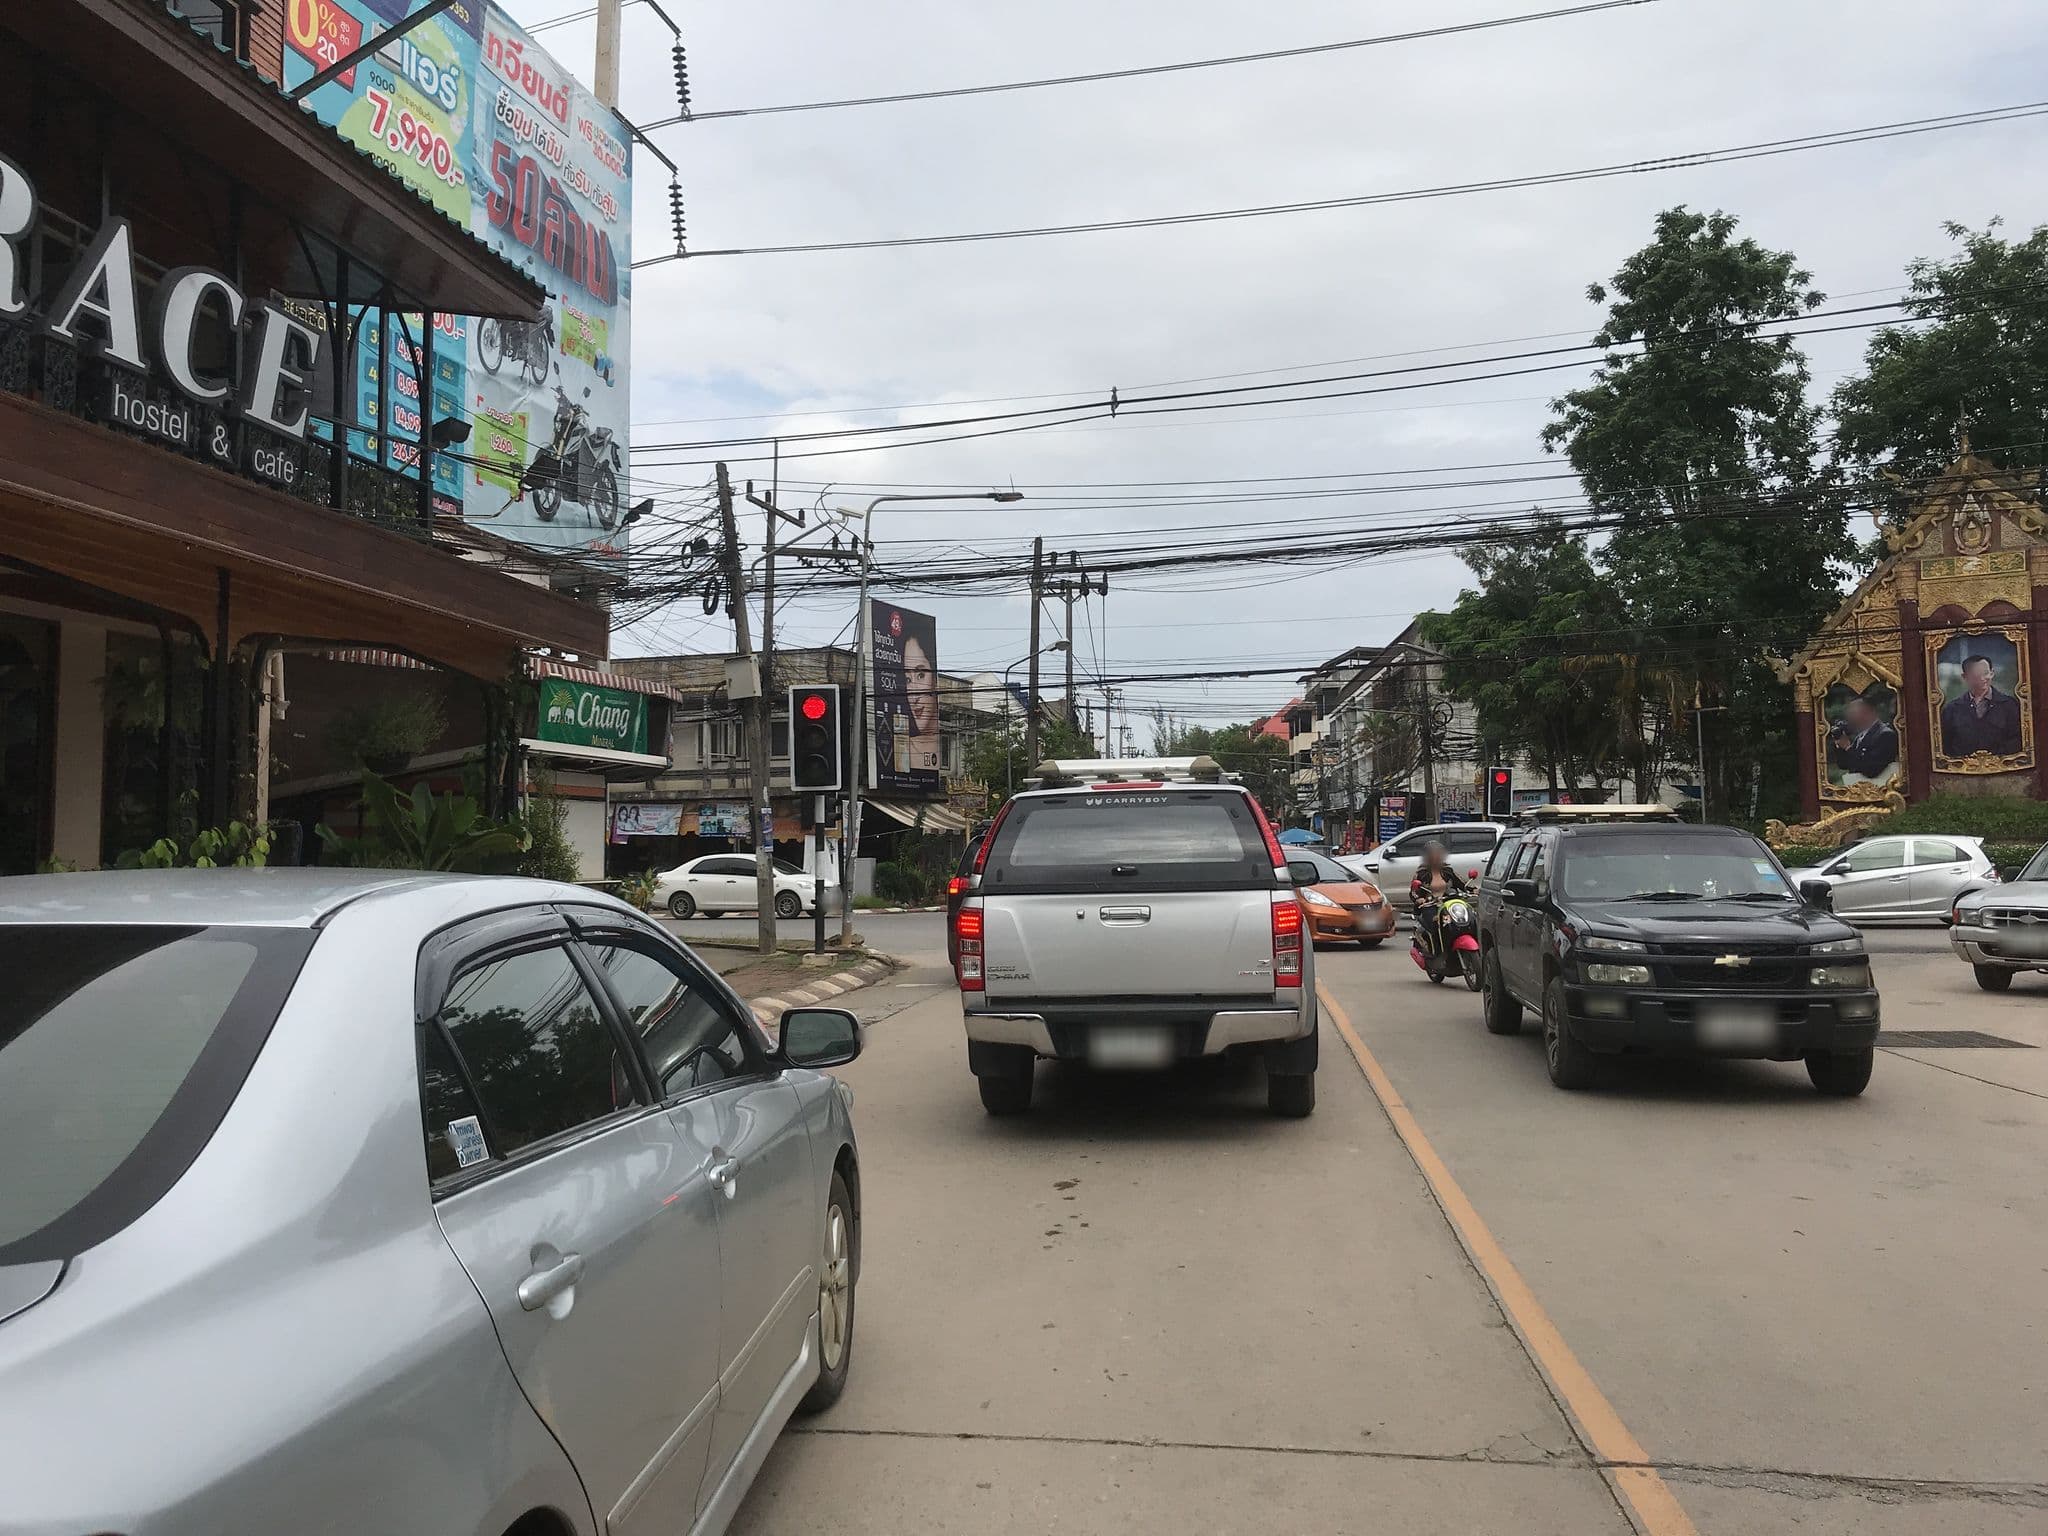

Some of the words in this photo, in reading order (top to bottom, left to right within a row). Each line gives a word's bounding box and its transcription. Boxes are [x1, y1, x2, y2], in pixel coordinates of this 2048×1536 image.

[317, 36, 337, 64] 20
[370, 71, 395, 95] 9000
[402, 39, 459, 107] แอร์
[487, 31, 569, 123] ทวียนต์
[368, 89, 463, 184] 7,990.-
[113, 384, 189, 442] hostel
[212, 424, 229, 458] &
[254, 445, 295, 483] cafe
[577, 692, 630, 738] Chang
